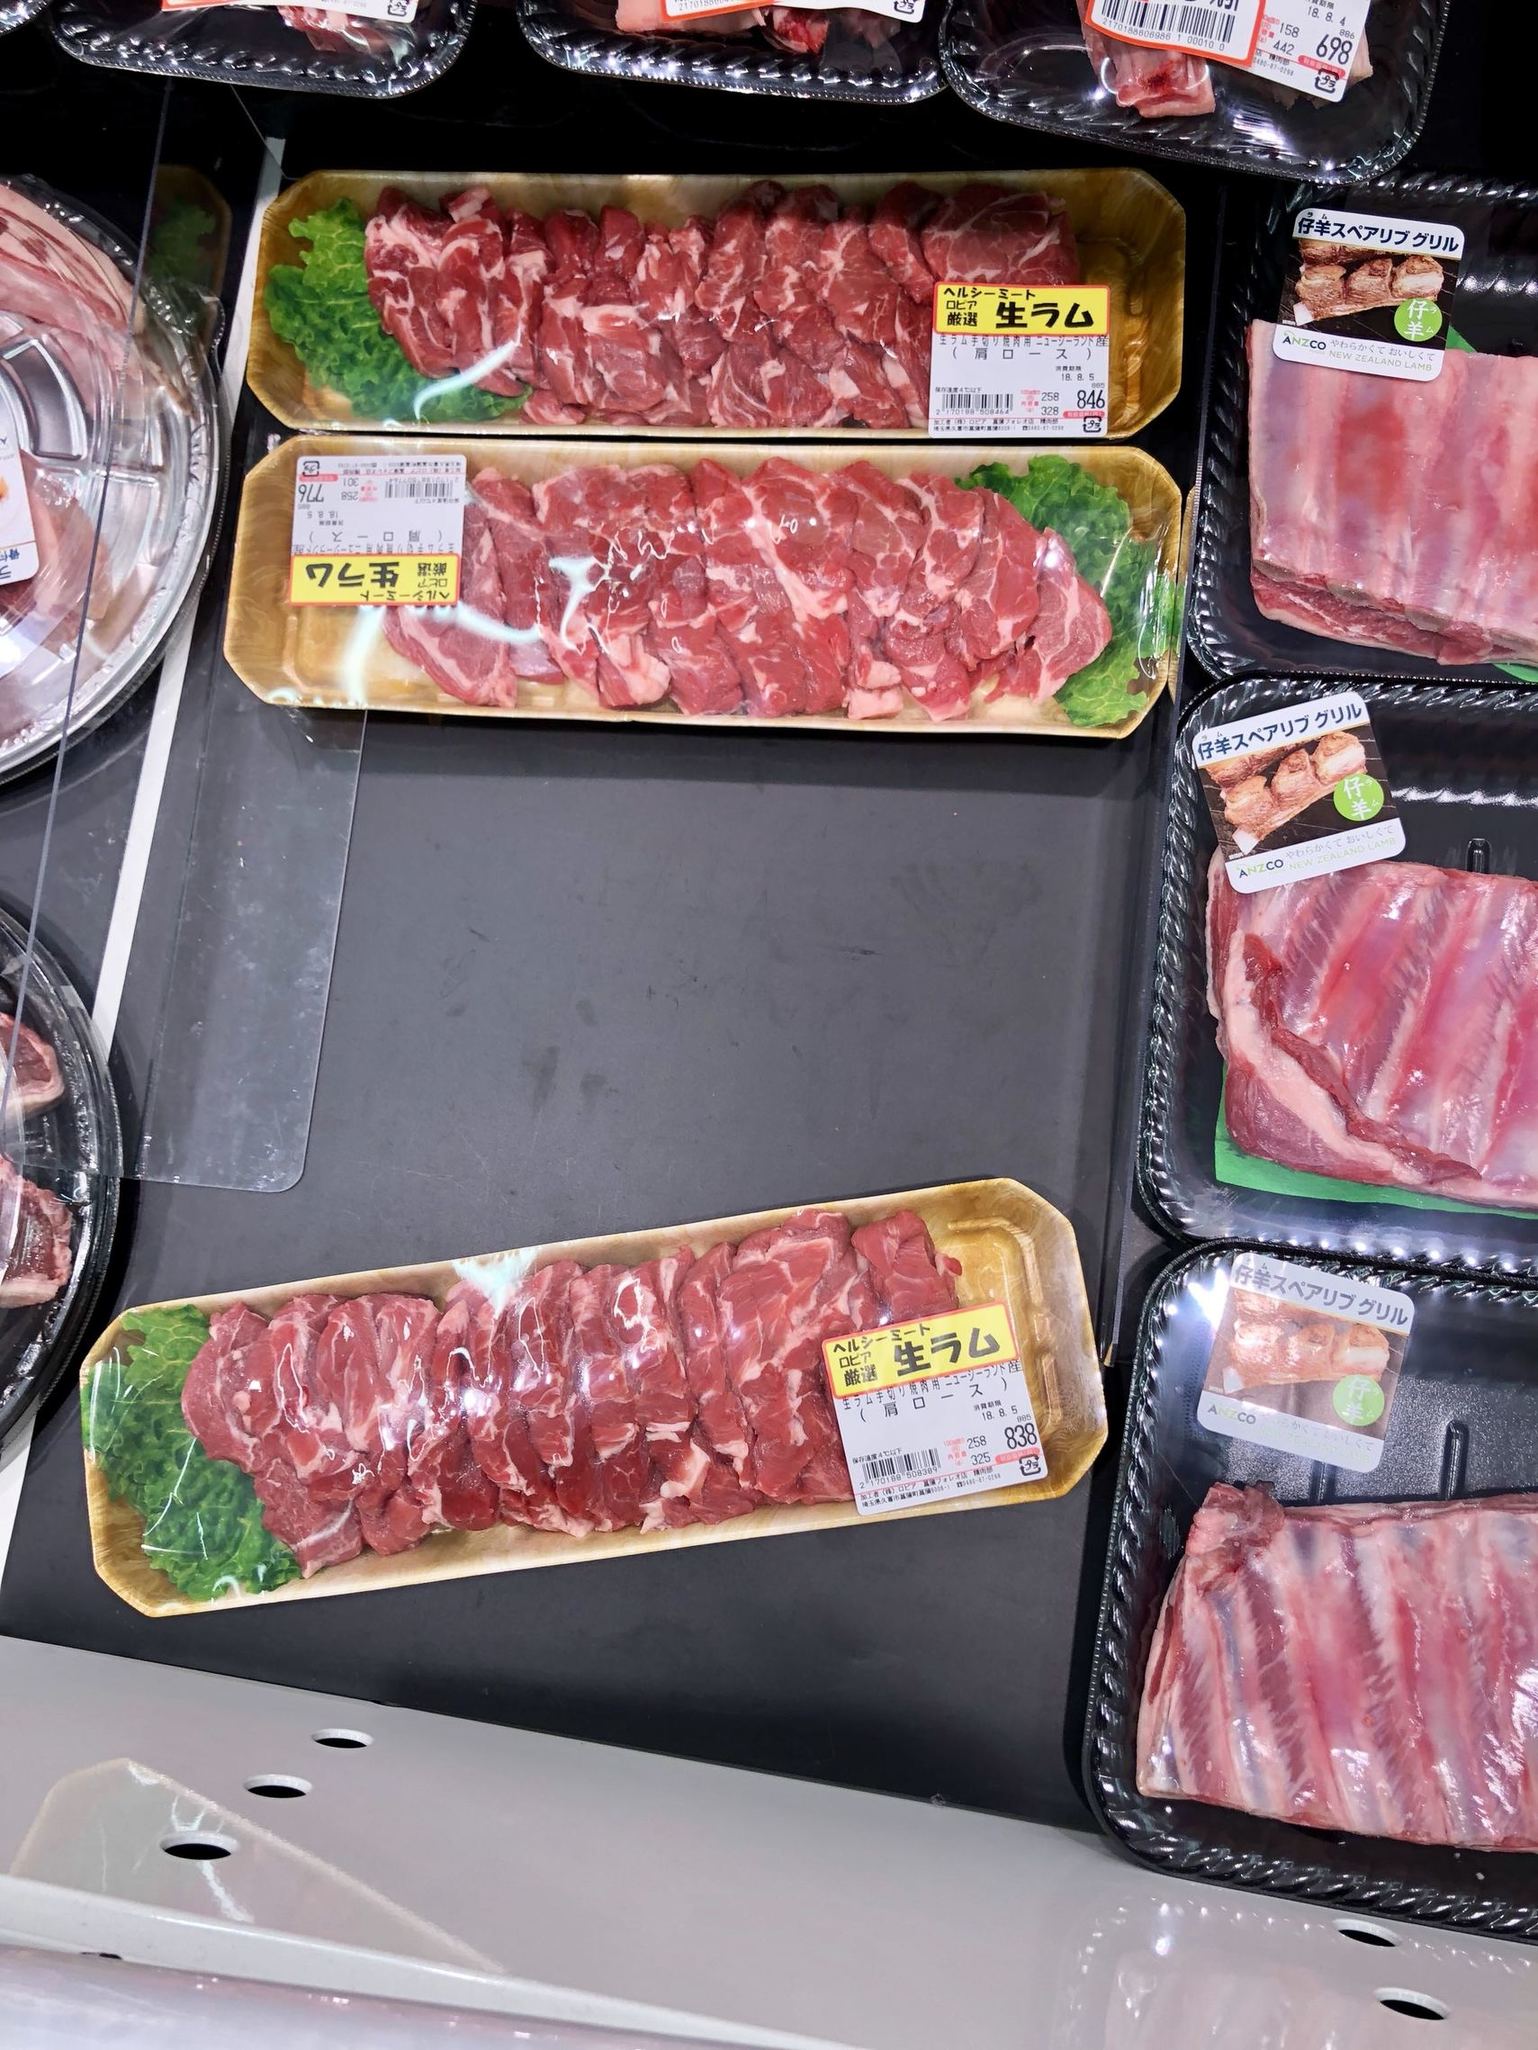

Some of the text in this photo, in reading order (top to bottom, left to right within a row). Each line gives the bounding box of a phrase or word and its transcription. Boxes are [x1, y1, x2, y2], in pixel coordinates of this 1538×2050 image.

[1340, 16, 1346, 27] 4
[1280, 22, 1300, 38] 158
[1339, 29, 1355, 39] 886
[1187, 36, 1214, 49] 00010
[1273, 40, 1295, 56] 442
[1316, 34, 1353, 65] 698
[1298, 217, 1459, 252] 仔羊スペアリブ グリル
[943, 287, 1036, 300] ヘルシーミート
[947, 312, 978, 327] 厳選
[995, 301, 1094, 329] 生ラム
[1404, 299, 1428, 341] 仔羊
[1282, 335, 1327, 351] ANZCO
[1329, 350, 1432, 372] NEW ZEALAND LAMB
[1089, 373, 1095, 381] 5
[1041, 391, 1060, 402] 258
[1077, 389, 1106, 409] 846
[1041, 406, 1059, 416] 328
[342, 477, 359, 487] 301
[298, 484, 325, 503] 776
[341, 491, 359, 501] 258
[305, 561, 400, 589] 生ラム
[417, 562, 447, 577] 厳選
[360, 590, 450, 602] ヘルシーミート
[1198, 703, 1362, 761] 仔羊スペアリブ グリル
[1289, 857, 1314, 871] NEW
[1316, 845, 1365, 865] ZEALAND
[1238, 858, 1284, 878] ANZCO
[1234, 1264, 1408, 1326] 仔羊スペアリブ グリル
[833, 1323, 931, 1354] ヘルシーミート
[893, 1327, 1000, 1377] 生ラム
[844, 1363, 878, 1387] 厳選
[1011, 1405, 1018, 1415] 5
[966, 1435, 987, 1450] 258
[1004, 1422, 1038, 1450] 838
[970, 1451, 991, 1466] 325
[869, 1475, 902, 1487] 170188
[906, 1467, 938, 1480] 508389
